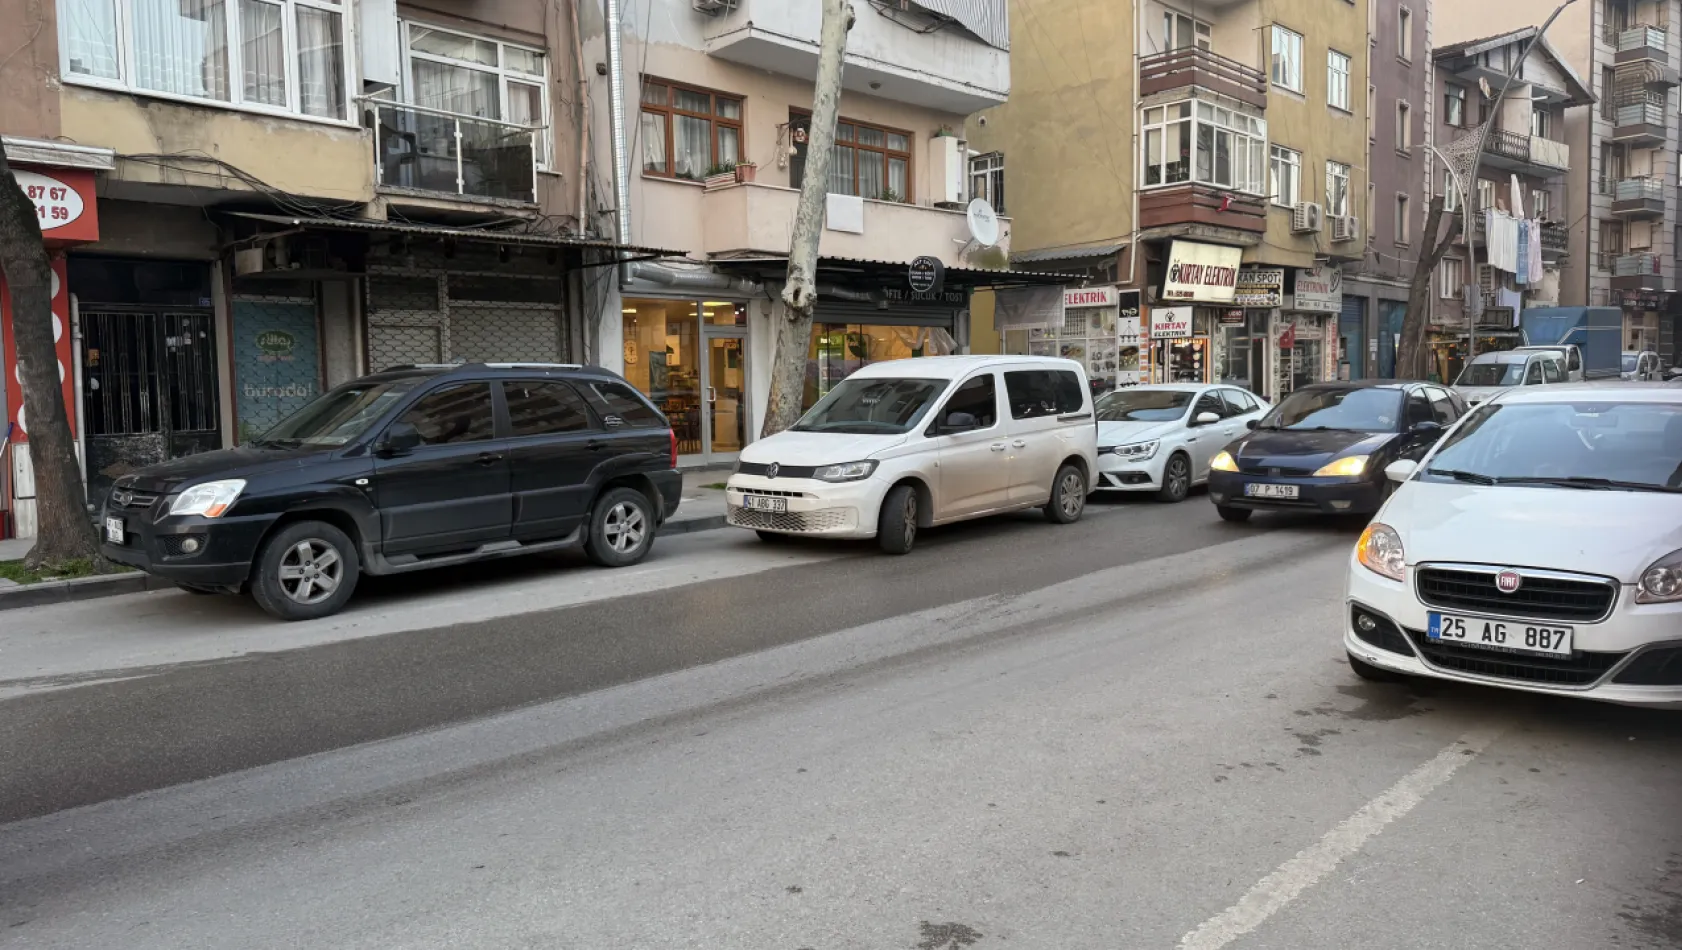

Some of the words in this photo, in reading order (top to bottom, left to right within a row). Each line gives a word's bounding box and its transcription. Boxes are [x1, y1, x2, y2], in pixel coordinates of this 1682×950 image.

[27, 185, 46, 200] 87
[49, 186, 67, 201] 67
[51, 206, 69, 220] 59
[1257, 273, 1278, 283] SPOT
[945, 292, 963, 302] TOST
[1065, 288, 1107, 305] ELEKTRİK
[1154, 321, 1187, 331] KIRTAY
[1501, 576, 1516, 586] FIAT
[1441, 617, 1466, 638] 25
[1481, 622, 1507, 644] AG
[1525, 627, 1566, 650] 887
